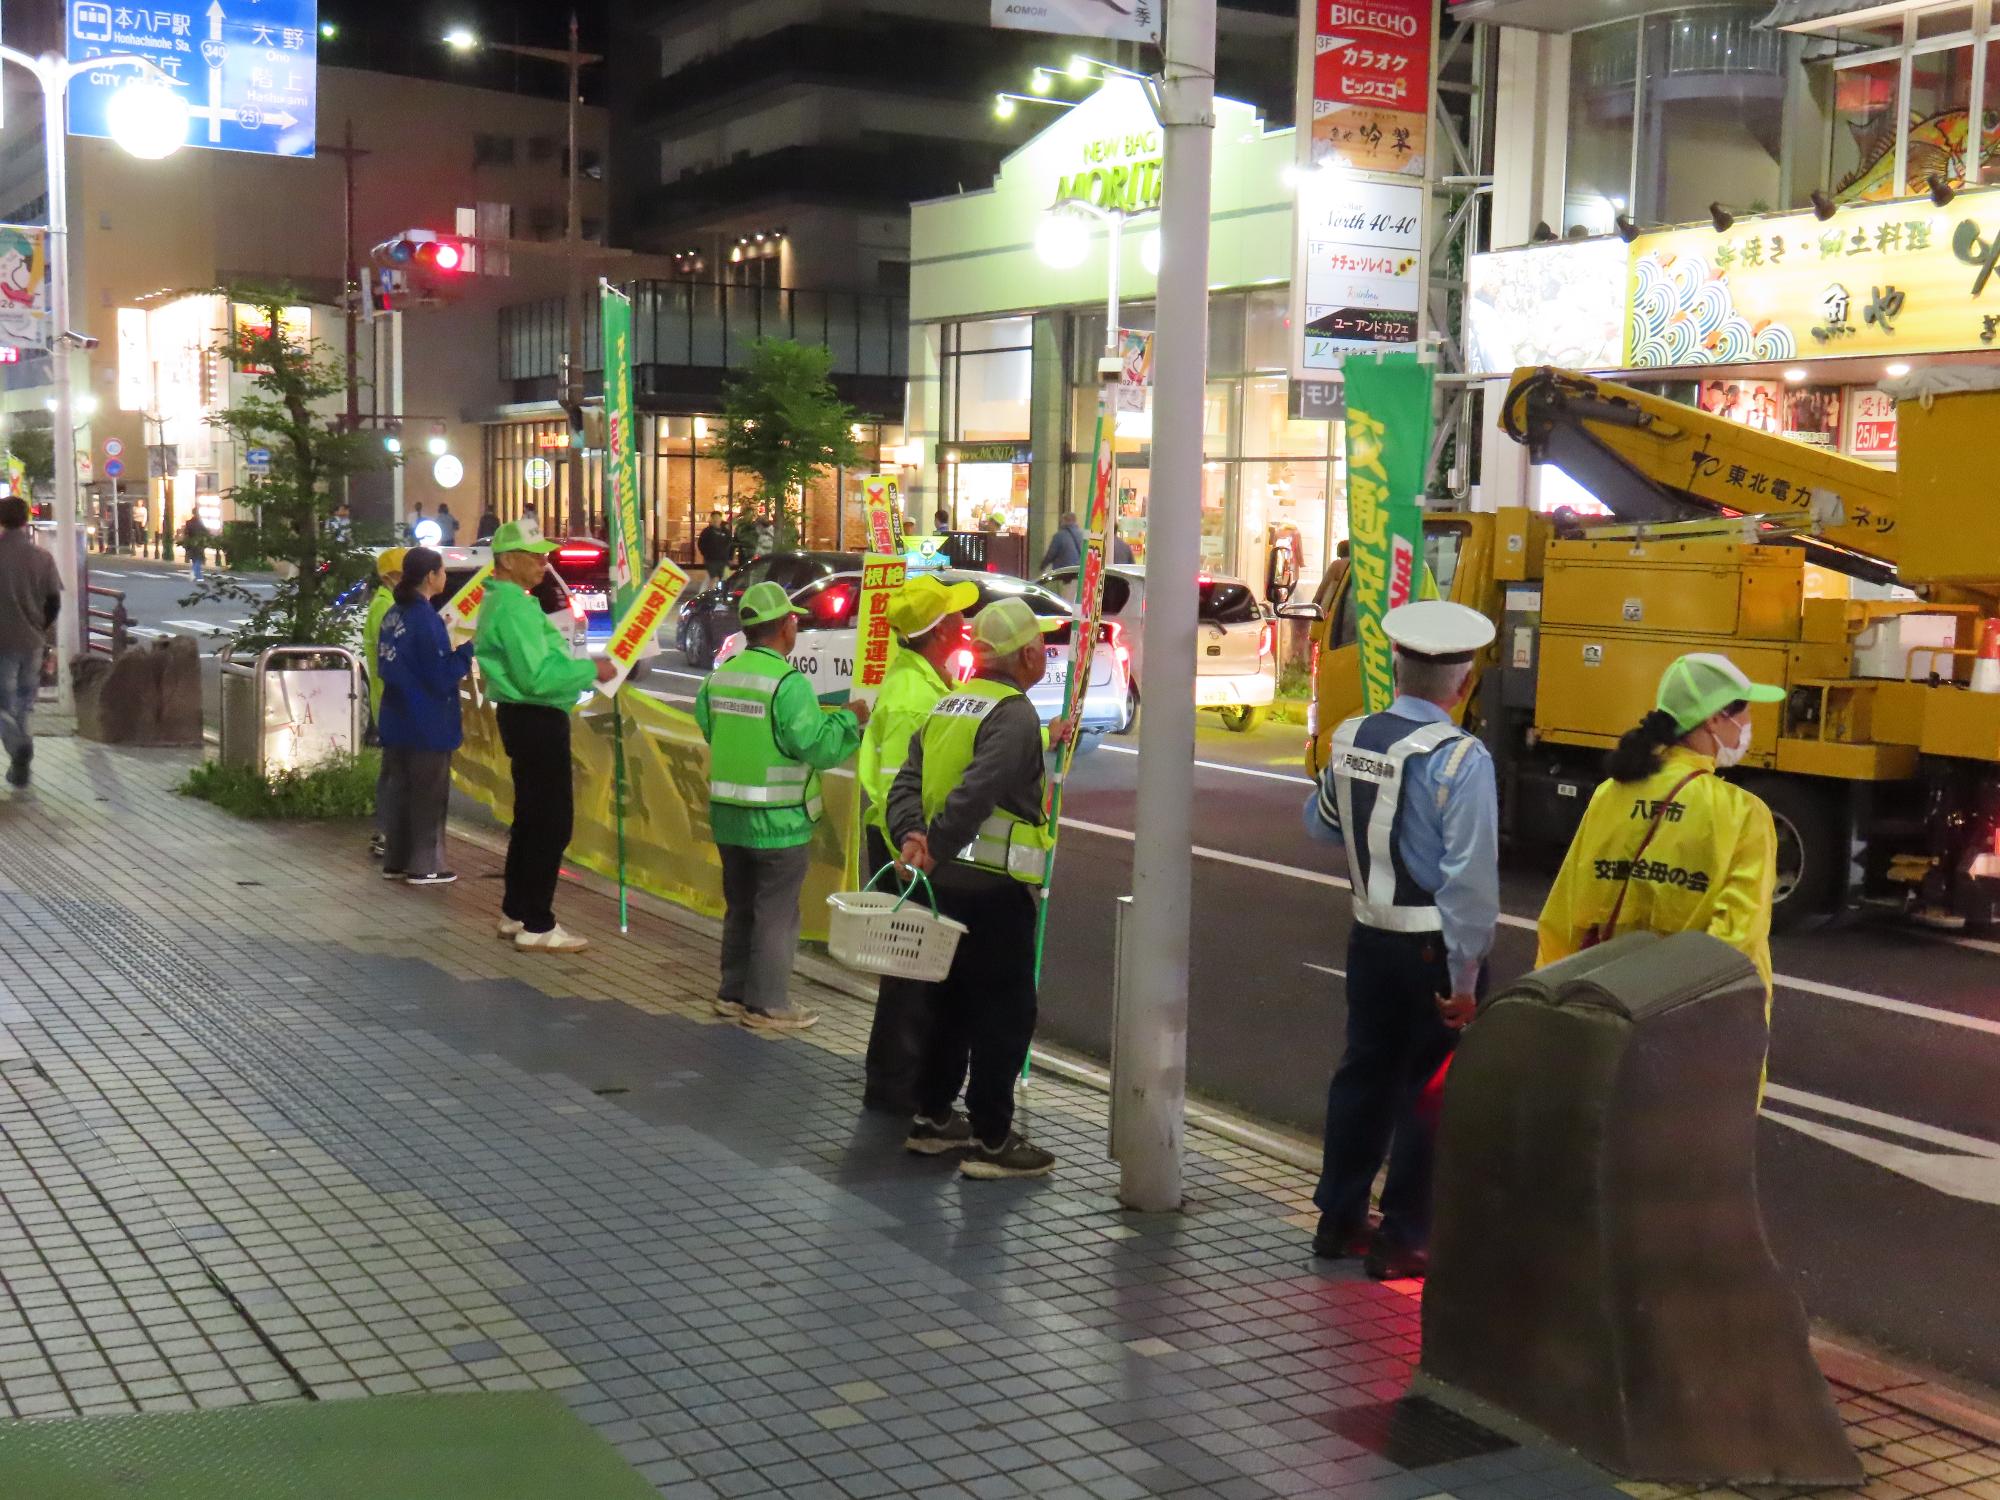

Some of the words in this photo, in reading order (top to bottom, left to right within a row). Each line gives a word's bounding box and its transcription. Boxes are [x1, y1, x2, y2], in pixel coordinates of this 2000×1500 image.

[1005, 4, 1047, 17] AOMORI
[1331, 4, 1364, 26] BIG
[1367, 12, 1417, 37] ECHO
[115, 7, 192, 37] 本八戸駅
[252, 25, 304, 50] 大野
[1317, 37, 1332, 49] 3F
[204, 44, 225, 58] 340
[1342, 47, 1408, 72] カラオケ
[90, 72, 121, 87] CITY
[252, 67, 304, 92] 階上
[1341, 74, 1407, 99] ビッグエコー
[240, 110, 260, 123] 251
[1315, 102, 1330, 113] 2F
[1083, 136, 1119, 164] NEW
[1369, 213, 1417, 235] 40-40
[1310, 243, 1324, 254] 1F
[1331, 254, 1392, 274] ナチュ・ソレイユ
[1308, 306, 1322, 318] 1F
[1811, 282, 1906, 345] 魚や
[1335, 318, 1354, 329] ユー
[1356, 319, 1382, 331] アンド
[1384, 322, 1409, 334] カフェ
[1725, 464, 1812, 508] 東北電力
[865, 567, 905, 587] 根絶
[862, 591, 892, 686] 飲酒運転
[1630, 799, 1687, 823] 八戸市
